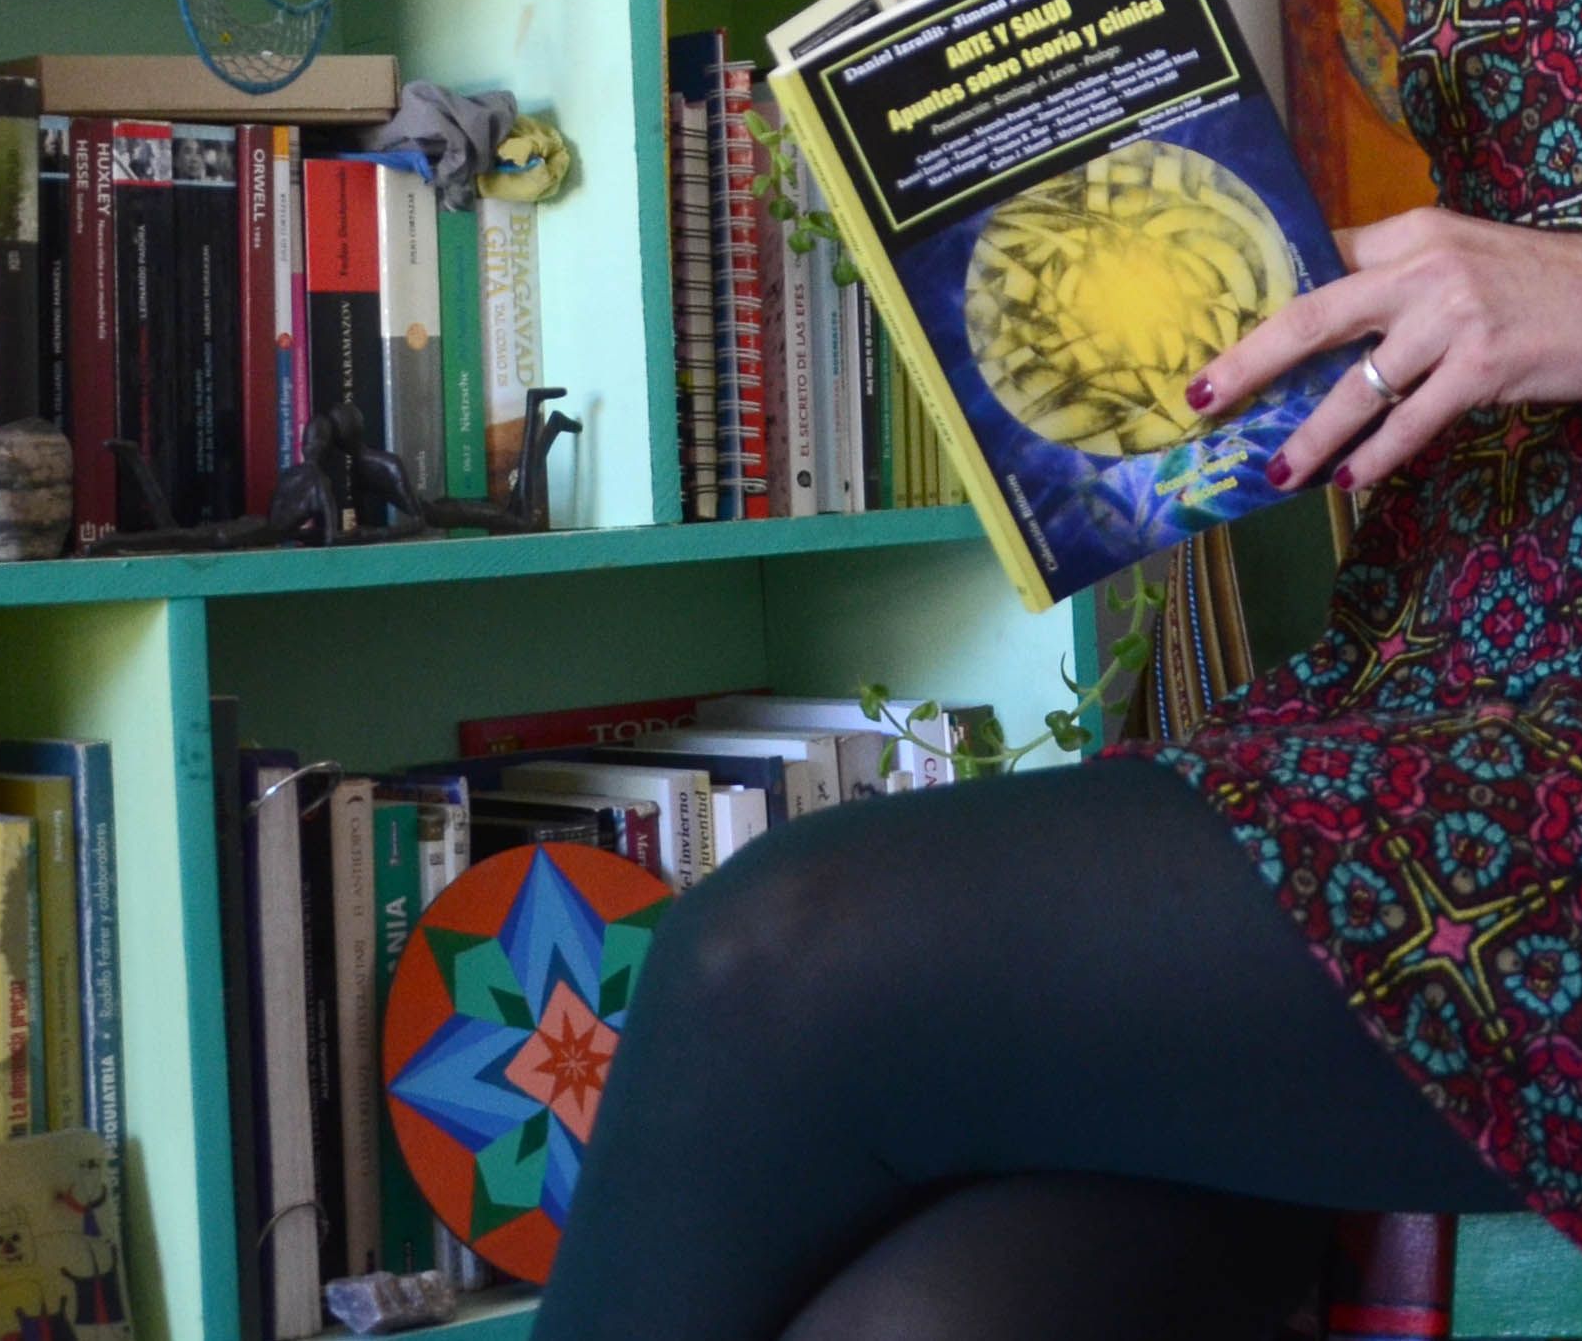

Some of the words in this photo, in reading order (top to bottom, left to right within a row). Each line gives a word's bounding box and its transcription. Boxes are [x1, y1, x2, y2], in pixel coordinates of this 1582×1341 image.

[843, 49, 895, 83] Daniel
[944, 30, 996, 70] ARTE
[992, 22, 1010, 46] Y
[887, 82, 966, 133] Apuntes
[965, 57, 1022, 95] sobre
[1020, 28, 1084, 69] teoría
[1081, 22, 1098, 49] y
[76, 139, 89, 190] HESSE
[97, 142, 111, 216] HUXLEY
[252, 148, 267, 222] ORWELL
[136, 224, 147, 264] PADURA
[480, 225, 511, 299] GITA
[98, 291, 107, 320] mundo
[137, 265, 148, 319] LEONARDO
[493, 302, 506, 327] TAL
[508, 213, 536, 388] BHAGAVAD
[793, 283, 806, 316] EFES
[97, 320, 106, 340] feliz
[340, 298, 354, 388] KARAMAZOV
[494, 328, 509, 370] COMO
[794, 321, 807, 346] LAS
[795, 351, 808, 369] DE
[457, 370, 472, 433] Nietzsche
[795, 374, 810, 438] SECRETO
[796, 442, 811, 457] EL
[678, 790, 691, 868] invierno
[696, 789, 709, 869] juventud
[92, 822, 110, 912] colaboradores
[97, 969, 114, 1019] Rodolfo
